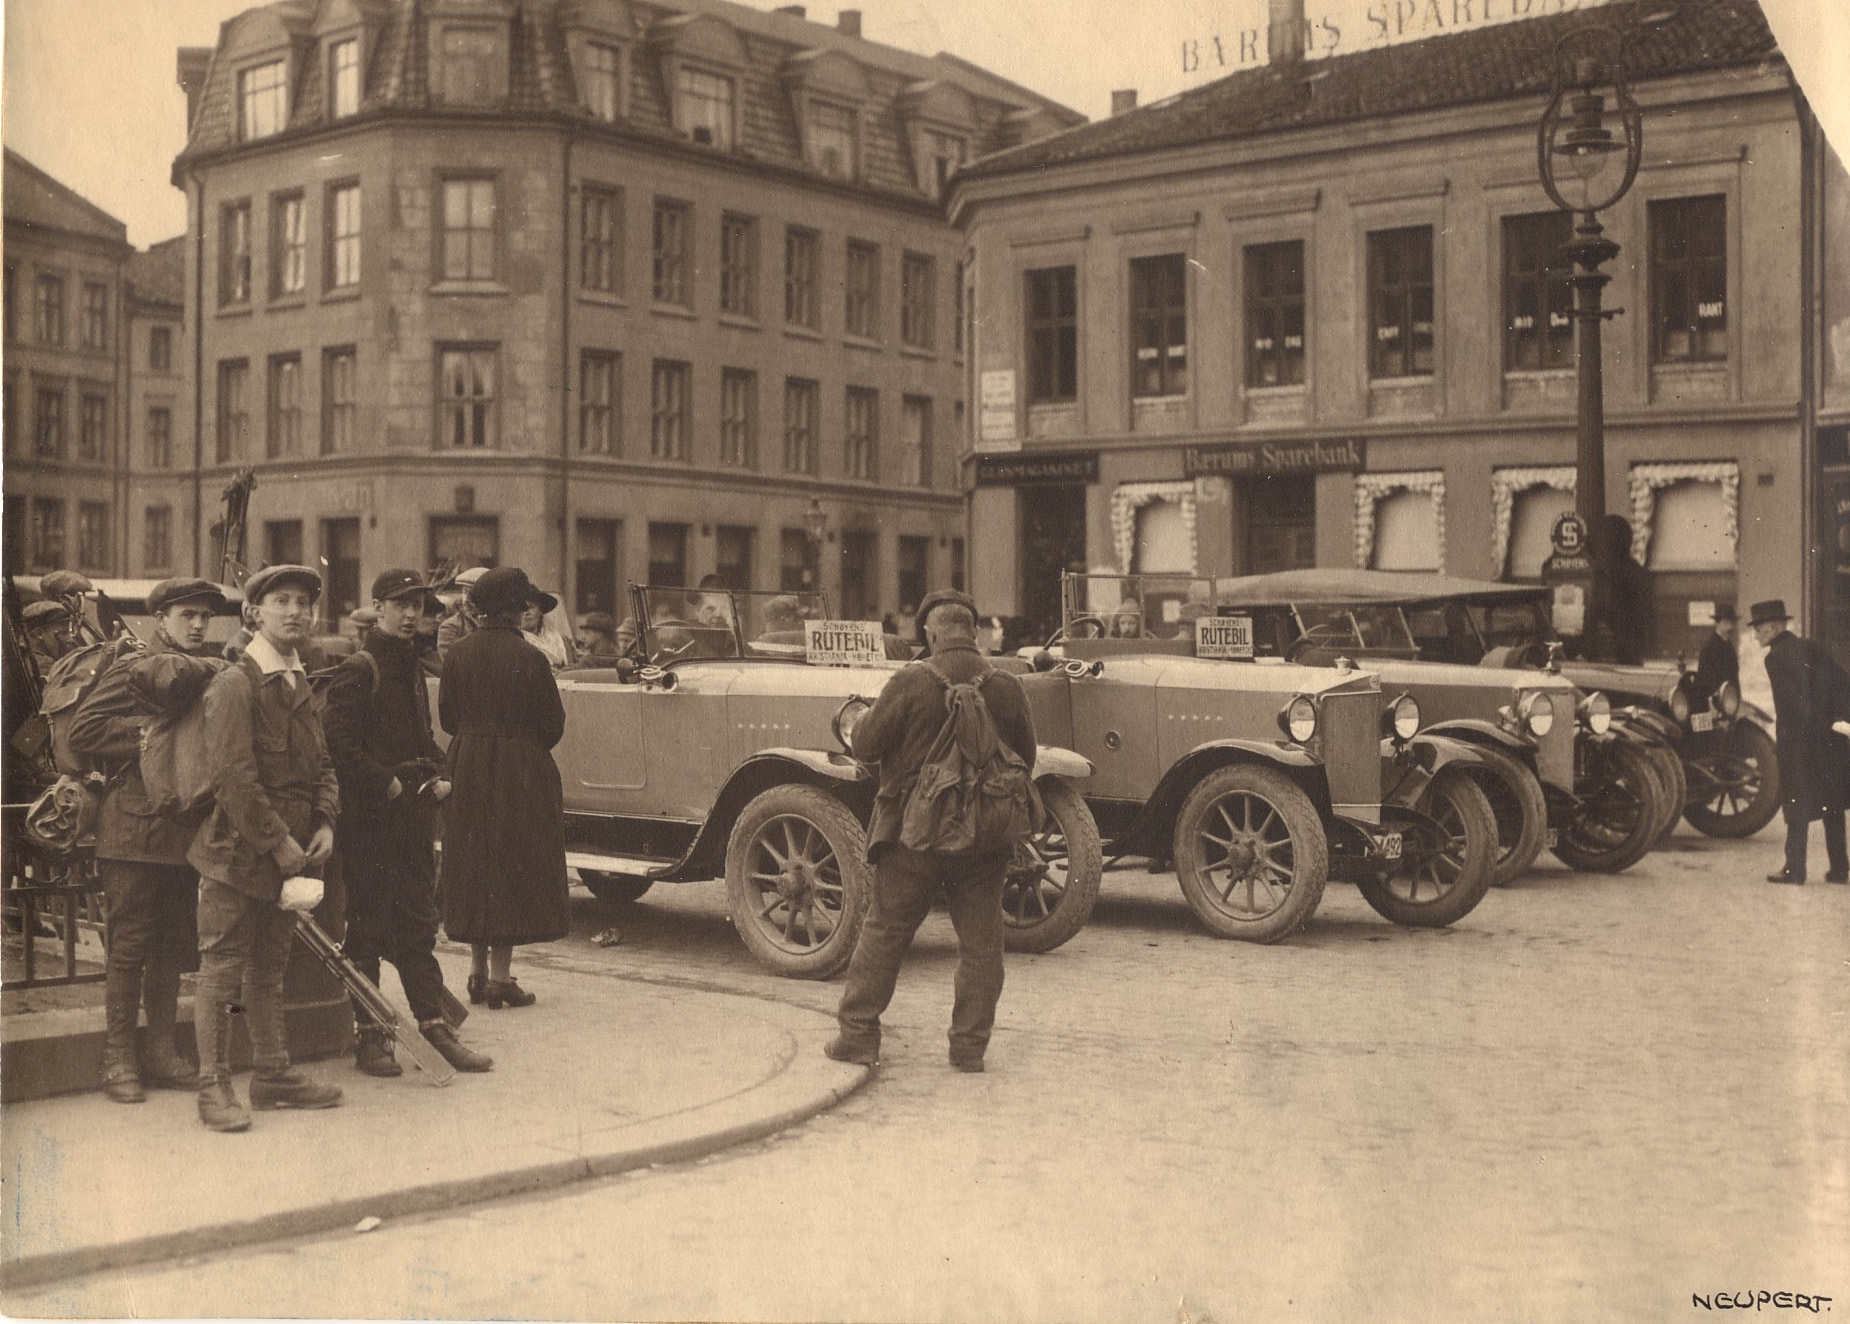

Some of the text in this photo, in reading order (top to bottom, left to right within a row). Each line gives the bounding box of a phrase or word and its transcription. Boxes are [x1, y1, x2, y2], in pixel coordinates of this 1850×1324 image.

[1262, 439, 1361, 471] Sparebank
[1562, 522, 1578, 547] S
[1201, 627, 1249, 645] RUTEBIL
